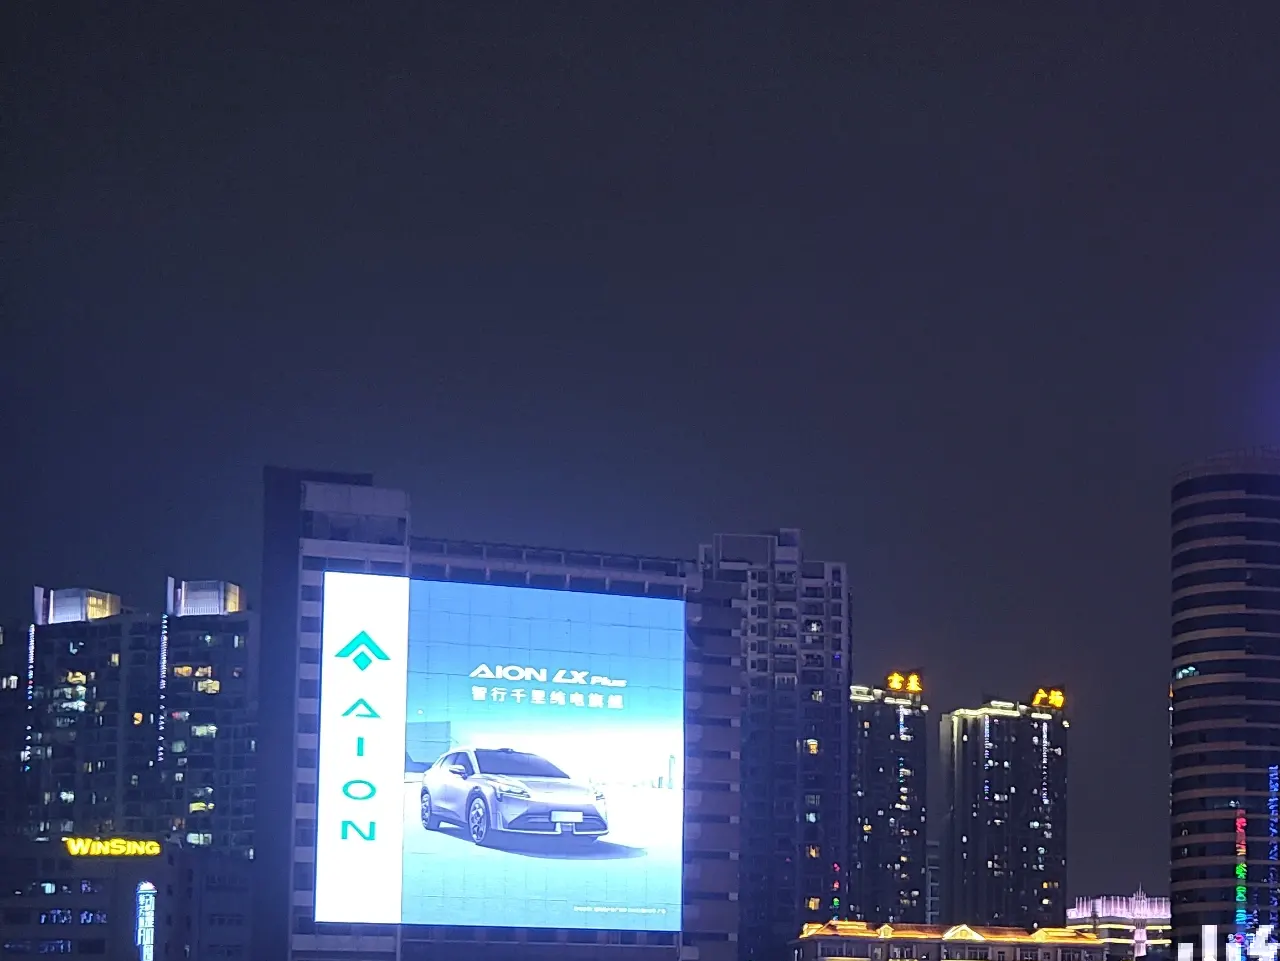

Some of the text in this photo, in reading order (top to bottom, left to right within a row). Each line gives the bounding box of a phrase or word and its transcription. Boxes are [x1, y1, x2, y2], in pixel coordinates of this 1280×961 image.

[469, 663, 547, 682] AION
[552, 669, 589, 685] LX
[342, 698, 381, 841] AION
